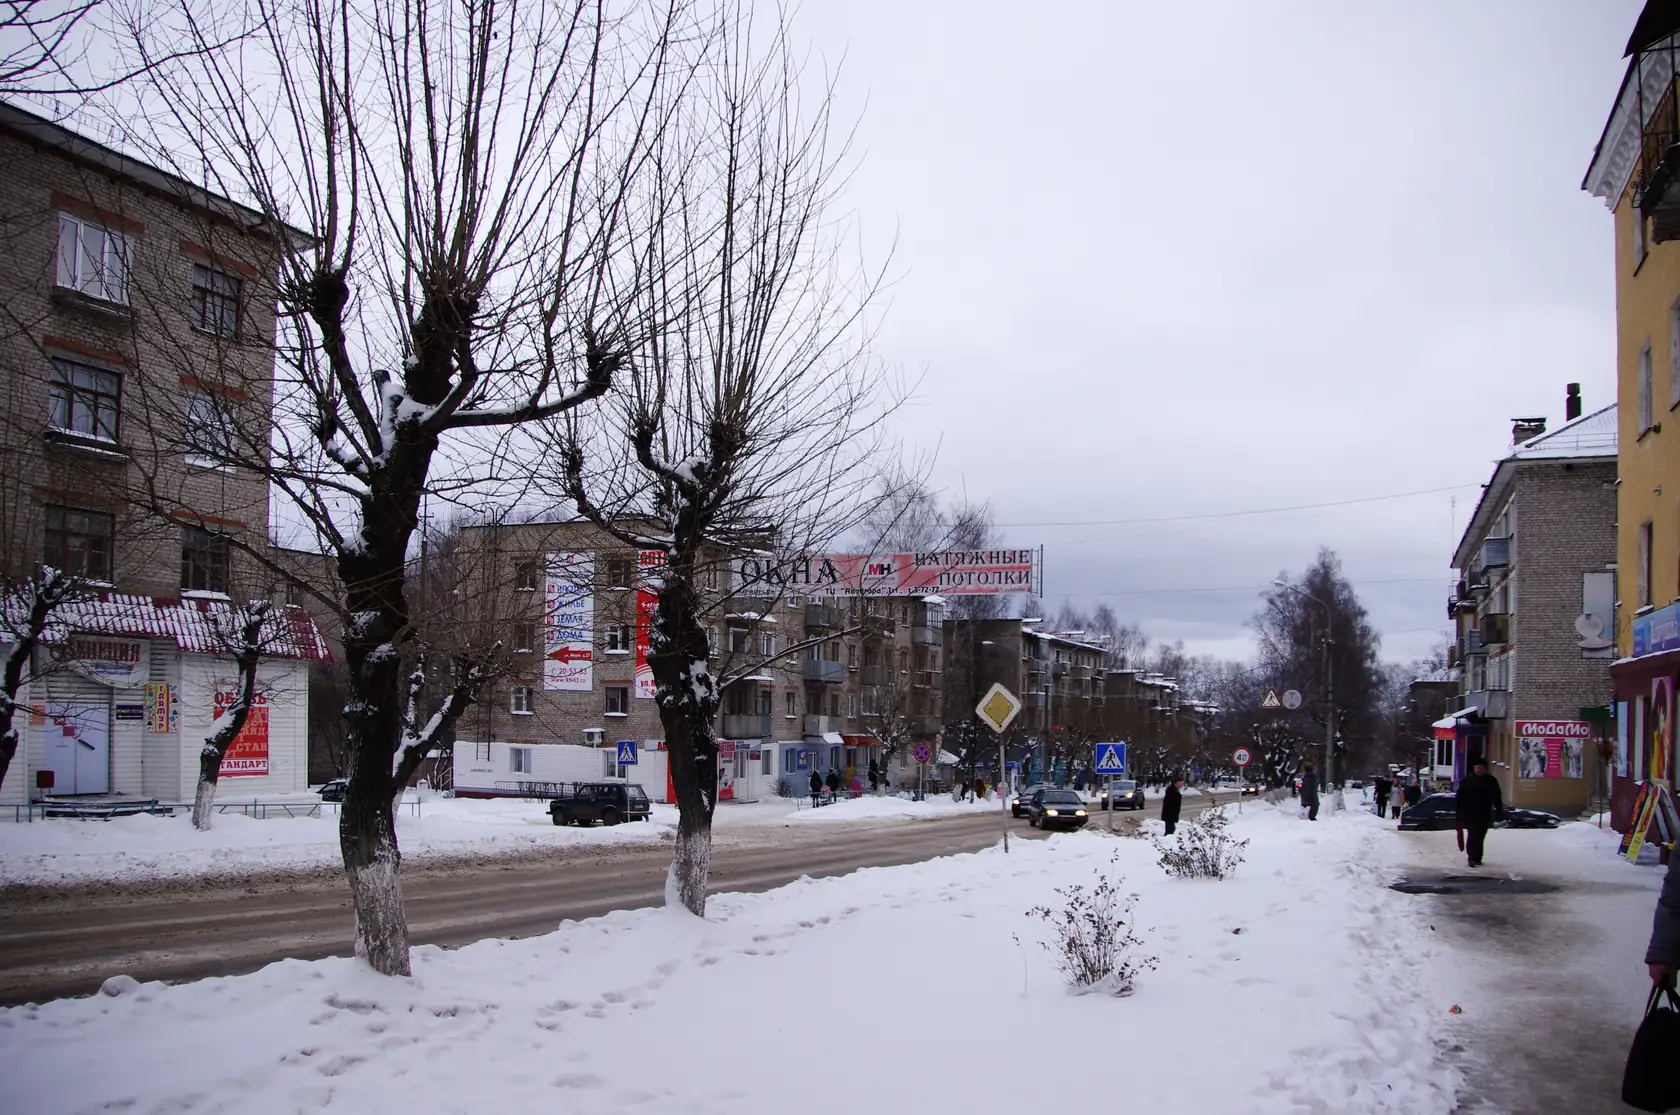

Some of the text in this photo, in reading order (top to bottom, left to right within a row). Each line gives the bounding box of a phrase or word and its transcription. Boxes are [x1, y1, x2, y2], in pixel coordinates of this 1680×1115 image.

[640, 551, 669, 566] АПТЕ
[915, 550, 1030, 566] НАТЯЖНЫЕ
[740, 559, 838, 584] ОКНА
[939, 571, 1030, 586] ПОТОЛКИ
[556, 615, 583, 624] ЗЕМЛЯ
[556, 631, 583, 640] ДОМА
[156, 685, 167, 729] ГЛАМУР
[220, 761, 267, 769] ТАНДАРТ
